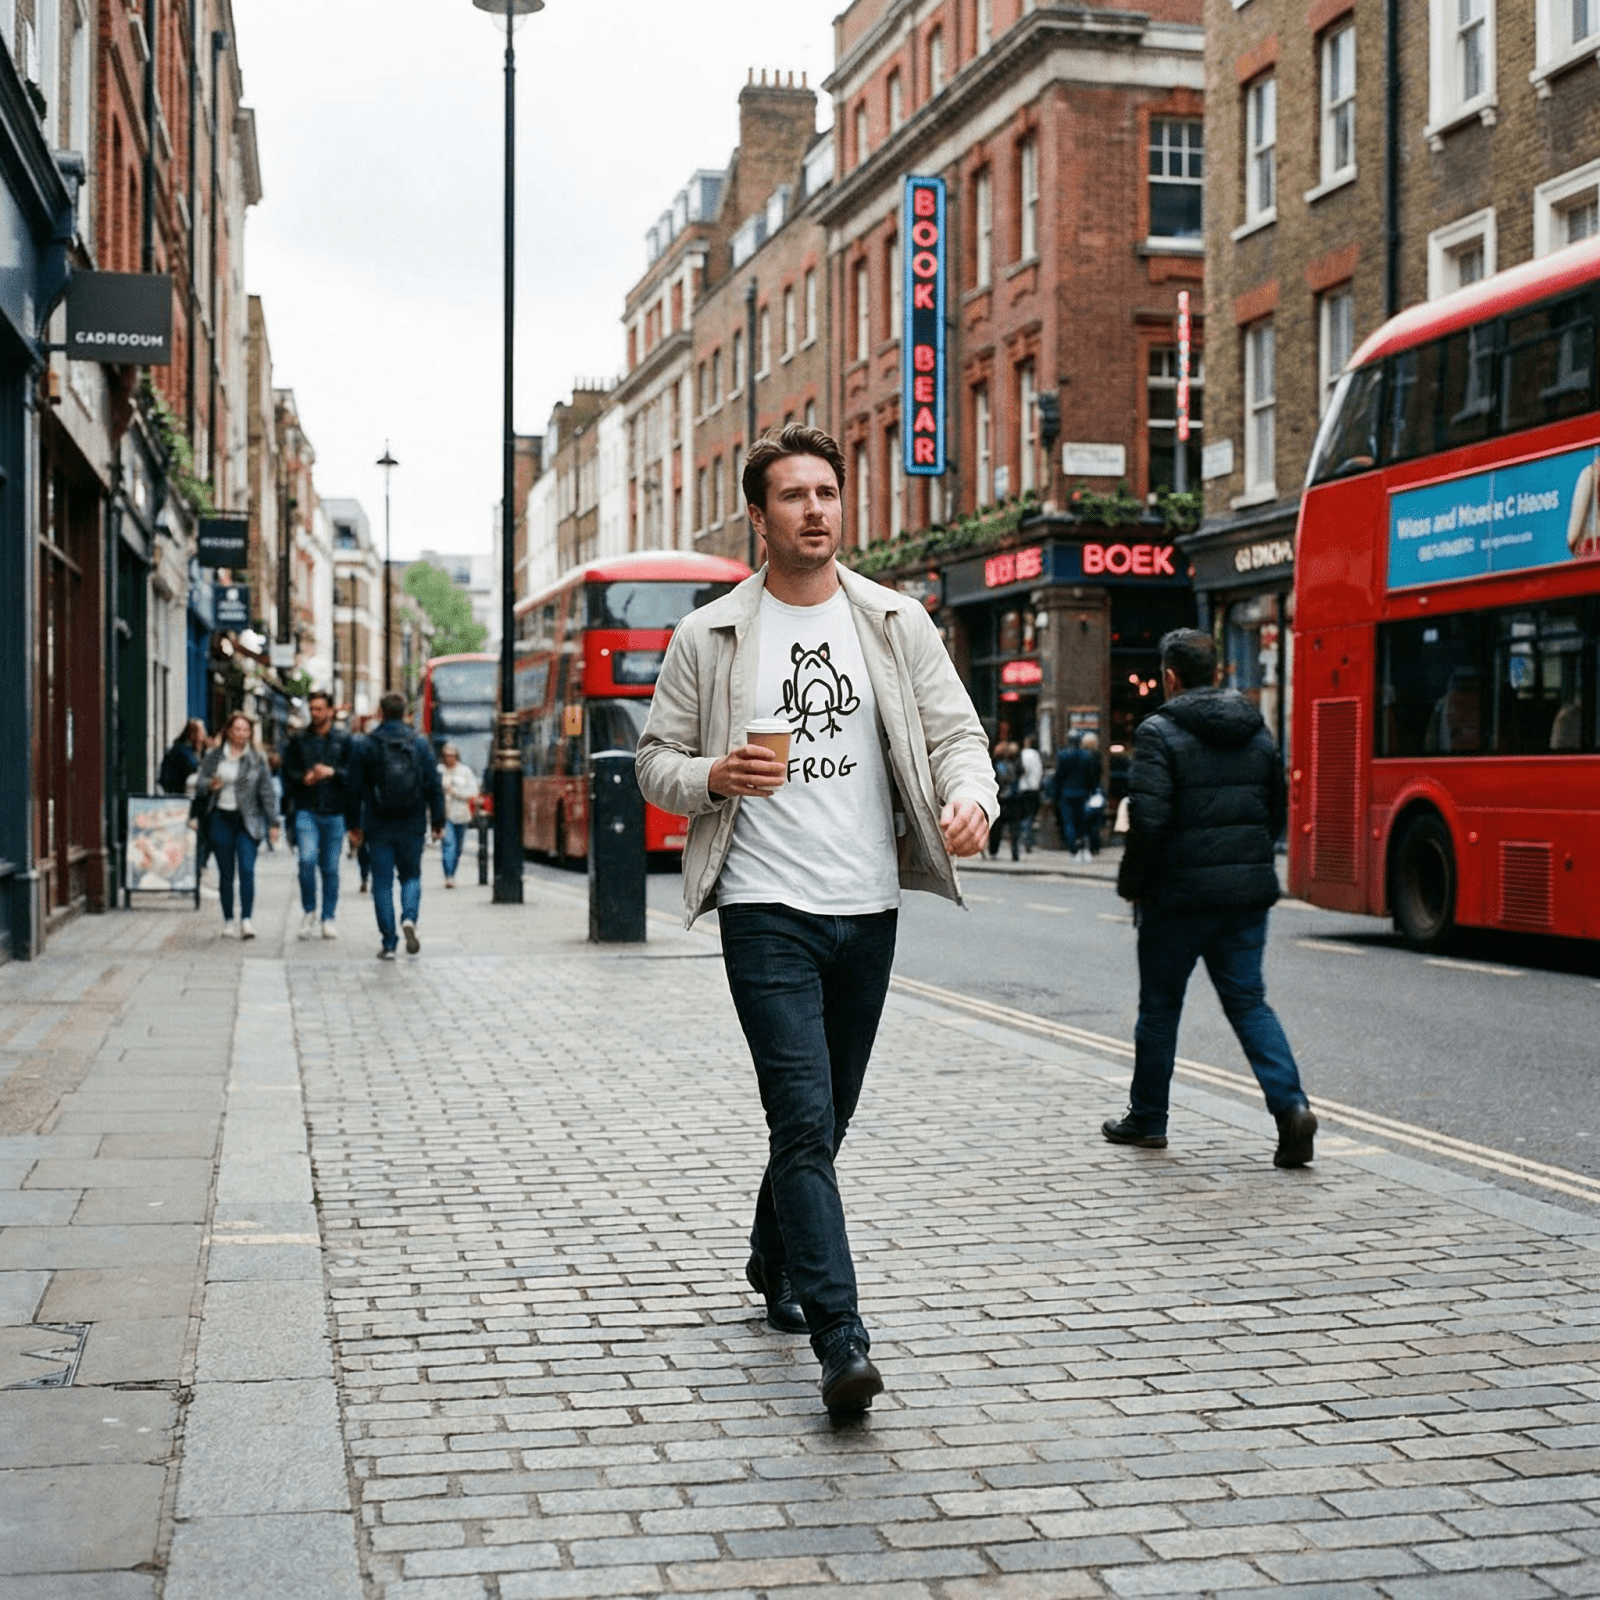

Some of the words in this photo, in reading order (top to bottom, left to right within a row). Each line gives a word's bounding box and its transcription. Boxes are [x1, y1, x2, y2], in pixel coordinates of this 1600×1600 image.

[912, 188, 938, 310] BOOK
[913, 344, 936, 464] BEAR
[1082, 543, 1175, 575] BOEK
[787, 755, 857, 783] FROG
